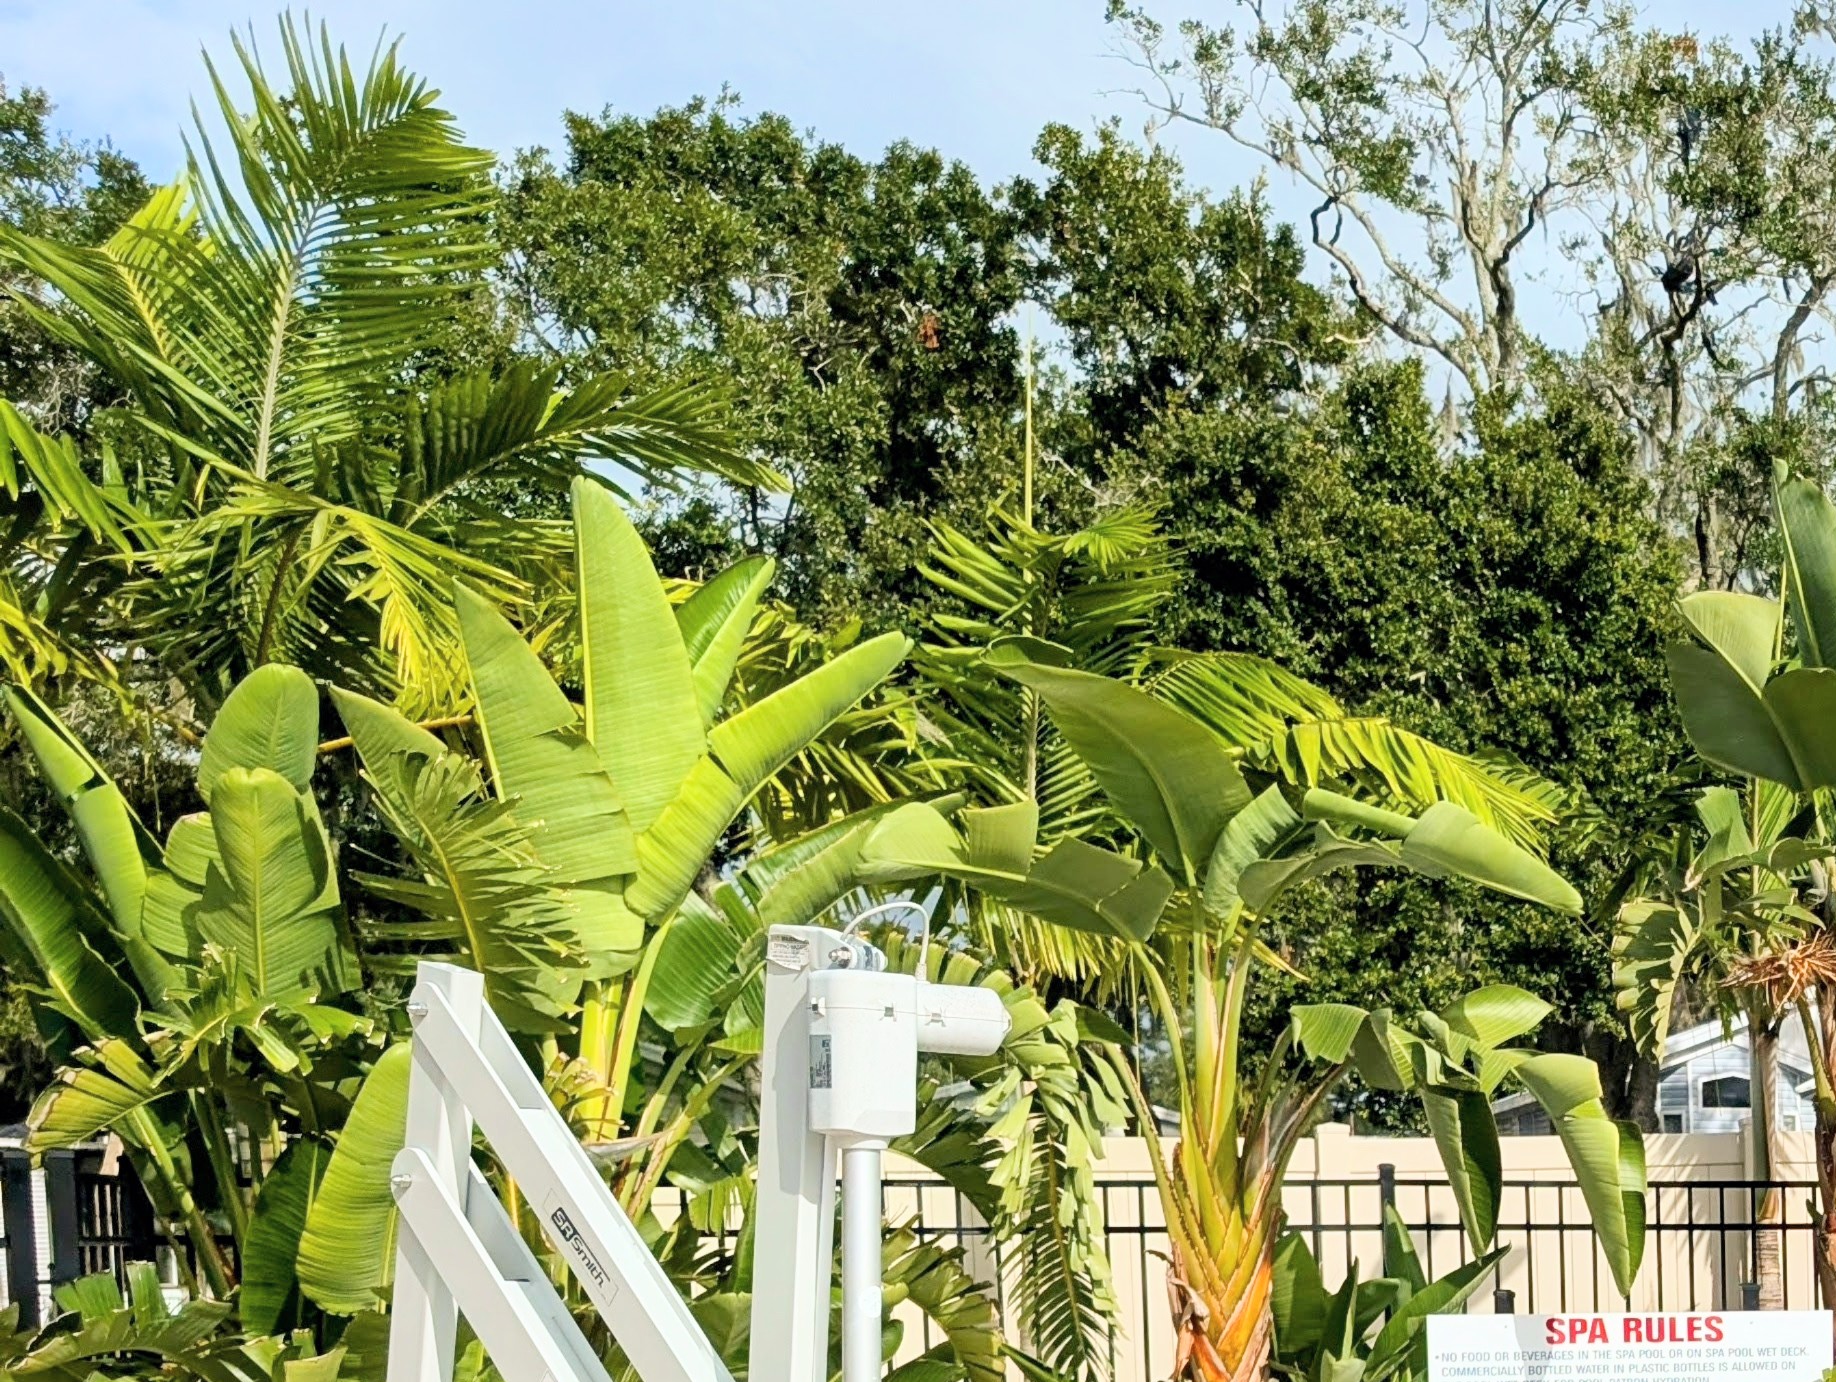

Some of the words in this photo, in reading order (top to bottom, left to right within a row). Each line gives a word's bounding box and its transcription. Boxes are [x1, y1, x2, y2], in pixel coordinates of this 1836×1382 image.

[1546, 1318, 1609, 1345] SPA
[1623, 1316, 1723, 1343] RULES
[1442, 1352, 1457, 1362] NO
[1462, 1351, 1490, 1362] FOOD
[1494, 1351, 1510, 1361] OR
[1514, 1350, 1574, 1361] BEVERAGES
[1578, 1350, 1588, 1360] IN
[1594, 1350, 1612, 1360] THE
[1616, 1349, 1635, 1359] SPA
[1638, 1349, 1666, 1359] POOL
[1669, 1349, 1682, 1359] OR
[1686, 1348, 1702, 1358] ON
[1706, 1348, 1724, 1358] SPA
[1728, 1348, 1754, 1358] POOL
[1756, 1347, 1778, 1357] WET
[1442, 1366, 1524, 1377] COMMERCIALLY
[1528, 1365, 1572, 1375] BOTTLED
[1576, 1364, 1610, 1374] WATER
[1613, 1364, 1624, 1374] IN
[1628, 1363, 1670, 1373] PLASTIC
[1674, 1362, 1715, 1373] BOTTLES
[1718, 1362, 1728, 1372] IS
[1732, 1361, 1778, 1371] ALLOWED
[1781, 1361, 1796, 1371] ON
